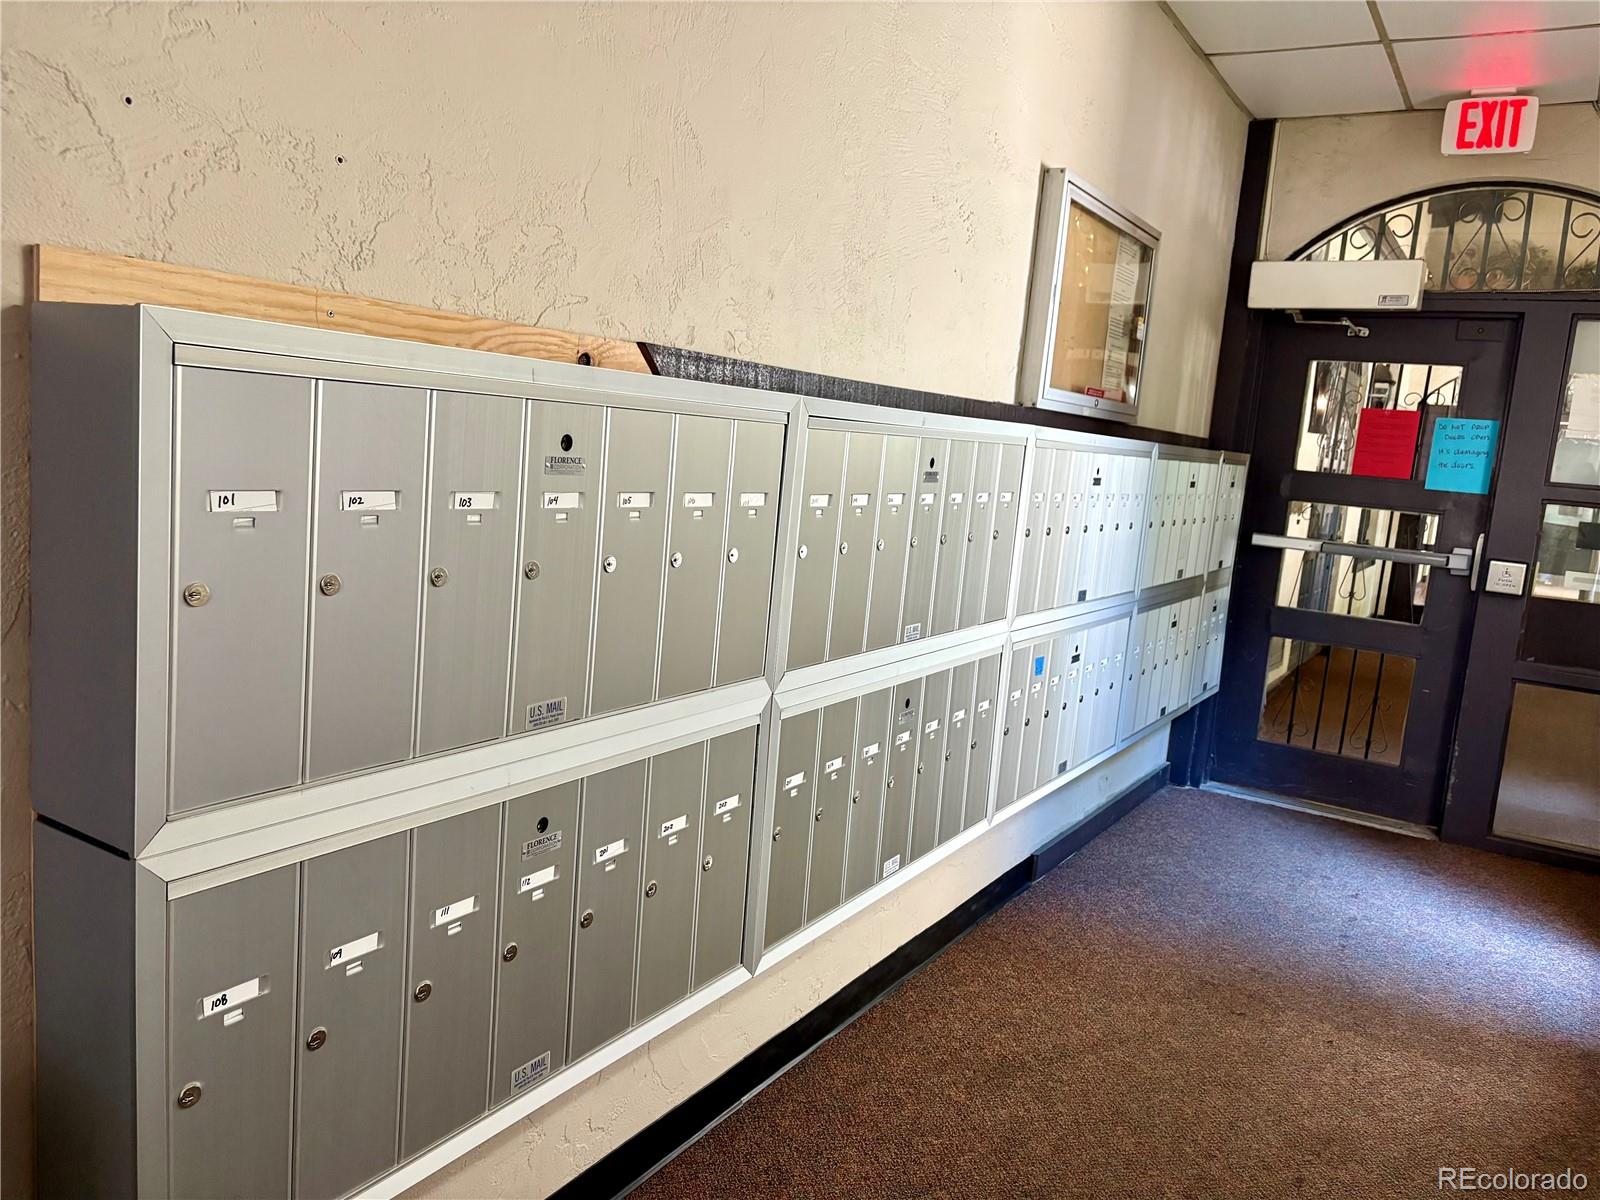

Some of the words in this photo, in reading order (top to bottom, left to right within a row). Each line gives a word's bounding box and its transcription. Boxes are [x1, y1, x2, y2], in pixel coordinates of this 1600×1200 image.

[1456, 99, 1529, 149] EXIT
[218, 493, 235, 508] 101
[348, 496, 364, 507] 102
[459, 497, 472, 507] 103
[547, 496, 559, 506] 104
[622, 496, 632, 505] 105
[530, 704, 544, 718] U.S.
[527, 833, 557, 849] FLORENCE
[441, 905, 450, 917] 111
[330, 948, 342, 962] 109
[211, 993, 228, 1011] 108
[515, 1067, 529, 1082] U.S.
